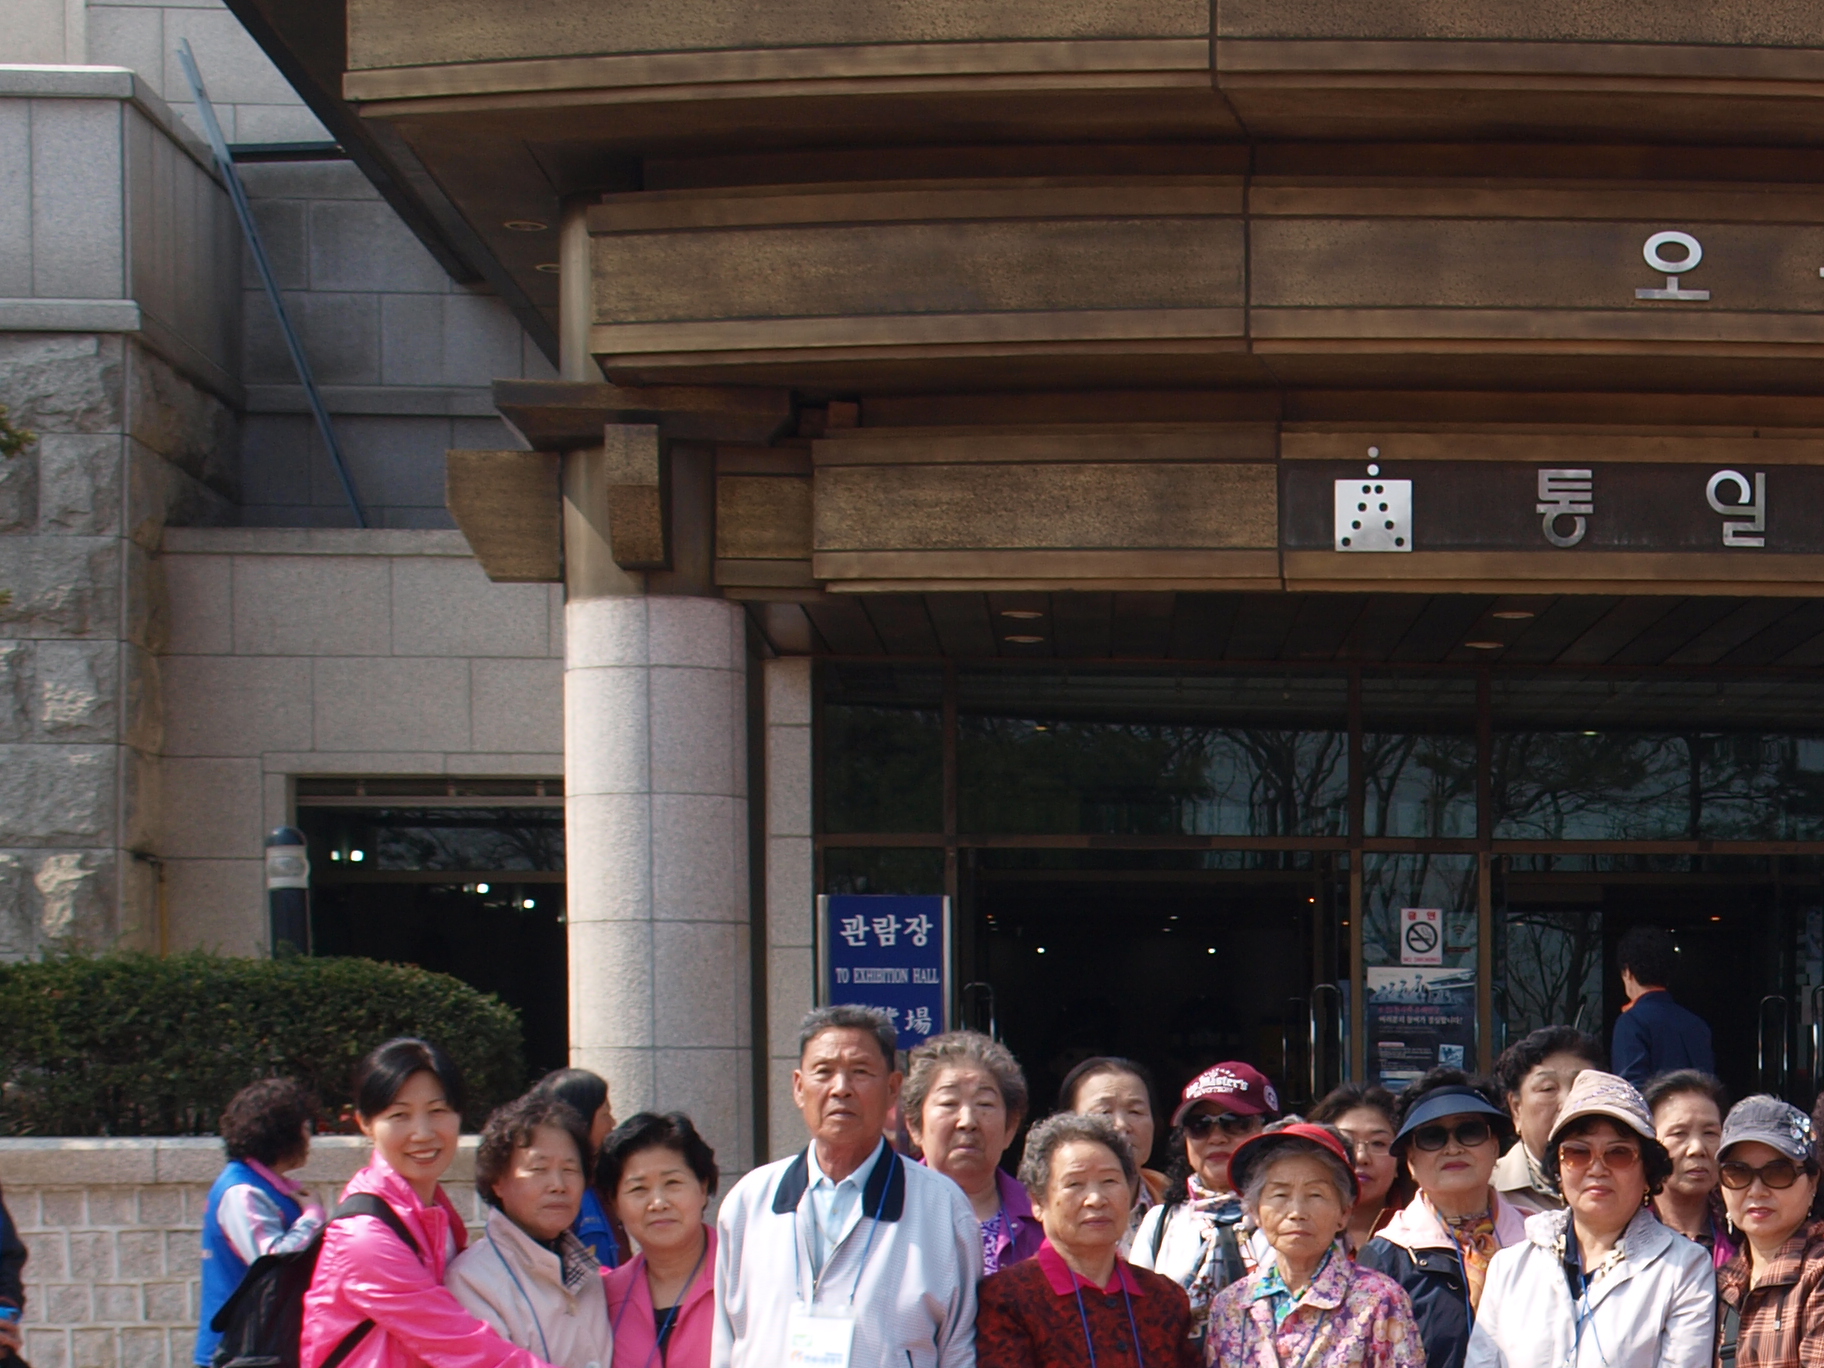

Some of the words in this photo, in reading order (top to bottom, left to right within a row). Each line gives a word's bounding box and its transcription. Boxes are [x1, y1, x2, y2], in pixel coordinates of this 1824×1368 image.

[840, 914, 933, 947] 관람장
[836, 968, 849, 984] TO
[853, 967, 909, 985] EXHIBITION
[913, 967, 940, 985] HALL
